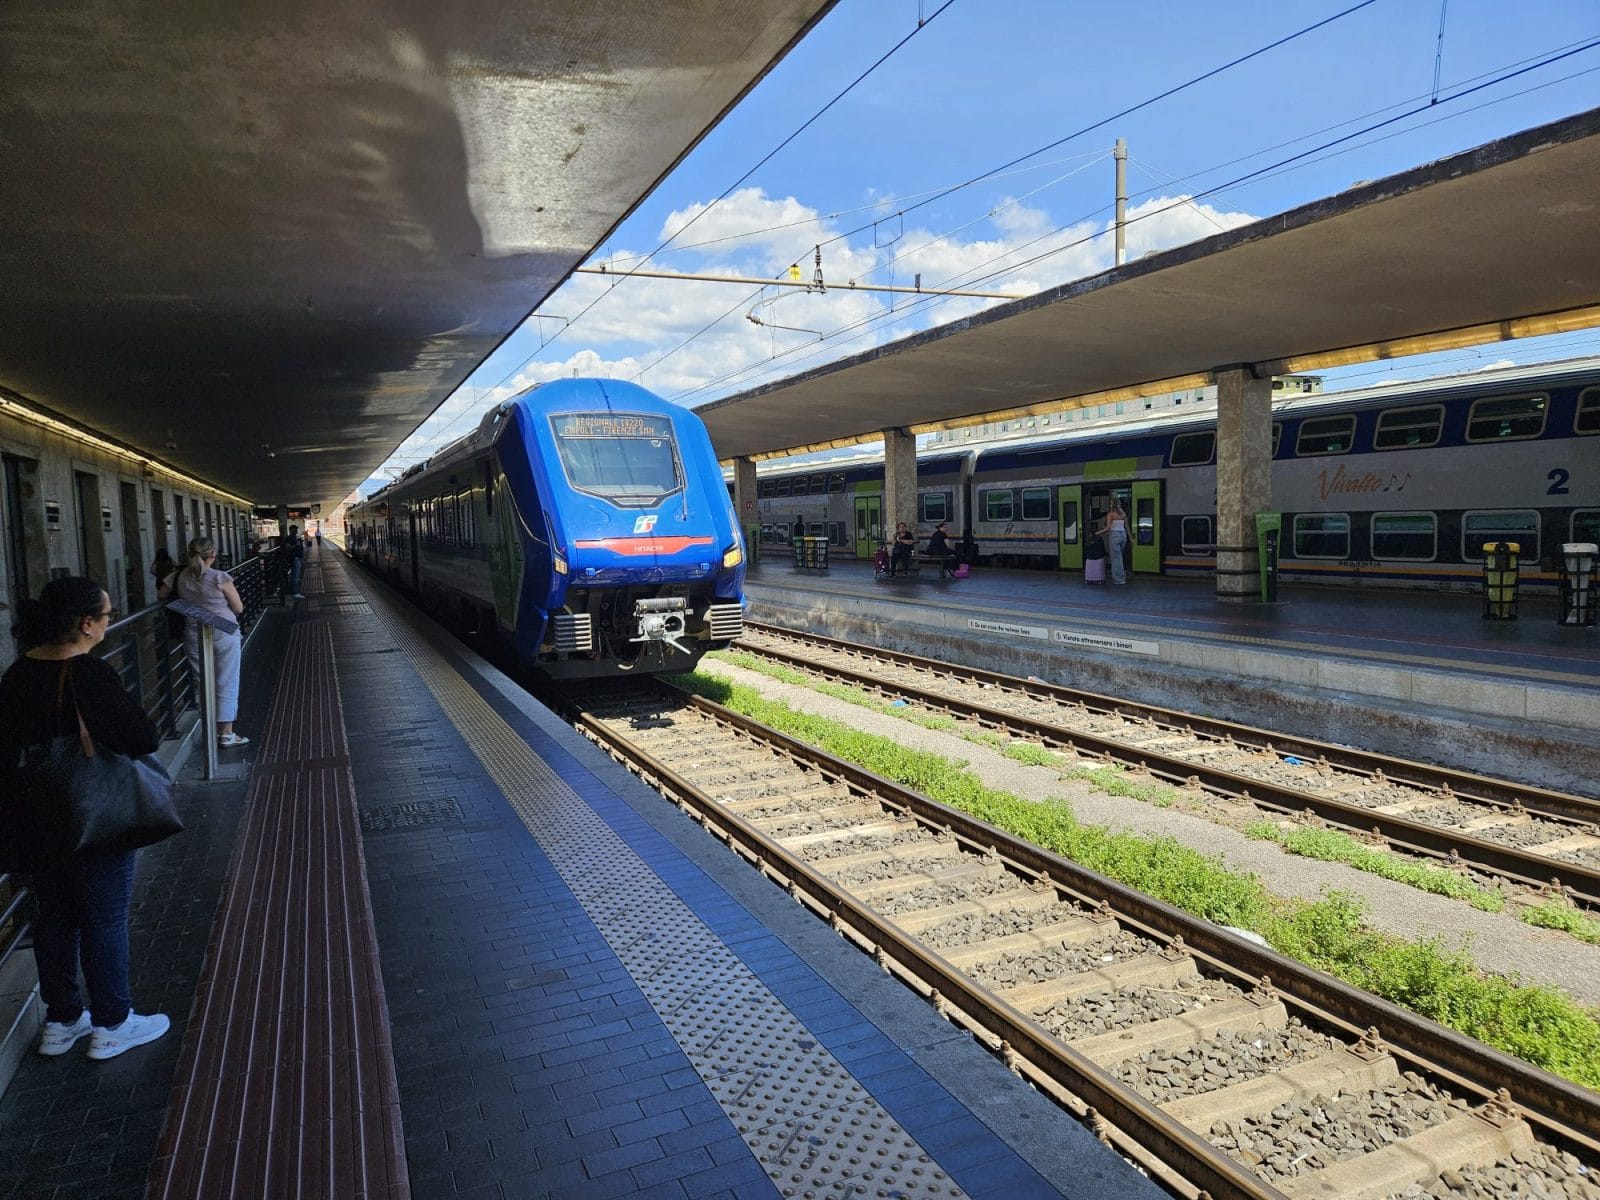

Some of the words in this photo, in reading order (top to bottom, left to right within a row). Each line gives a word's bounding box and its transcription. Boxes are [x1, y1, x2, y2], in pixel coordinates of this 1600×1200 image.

[576, 418, 617, 426] REGIONALE
[565, 426, 593, 434] EMPOLI
[603, 426, 636, 434] FIRENZE
[639, 427, 656, 435] SMN
[1318, 463, 1382, 500] Vivalto
[1546, 468, 1569, 495] 2
[824, 508, 828, 518] 2
[1063, 633, 1080, 642] Vietato
[1081, 637, 1112, 647] attraversare
[1117, 641, 1133, 649] binari
